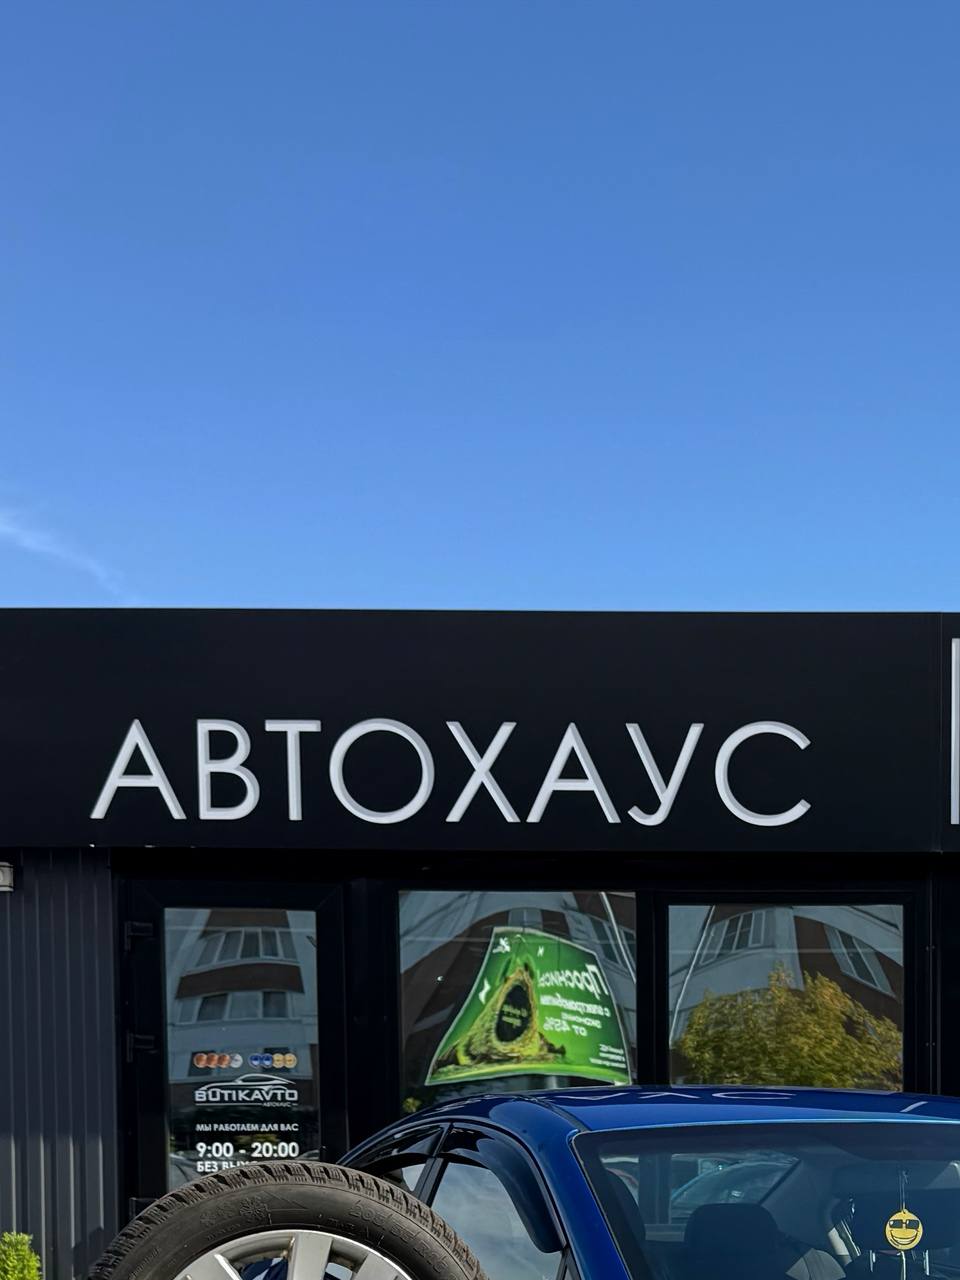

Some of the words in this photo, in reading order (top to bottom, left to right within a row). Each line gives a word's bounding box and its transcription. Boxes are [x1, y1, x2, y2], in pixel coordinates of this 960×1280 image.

[91, 719, 812, 826] АВТОХАУС
[195, 1089, 298, 1102] BUTIKAVTO
[196, 1142, 234, 1158] 9:00
[251, 1142, 300, 1158] 20:00
[196, 1161, 218, 1172] БЕЗ
